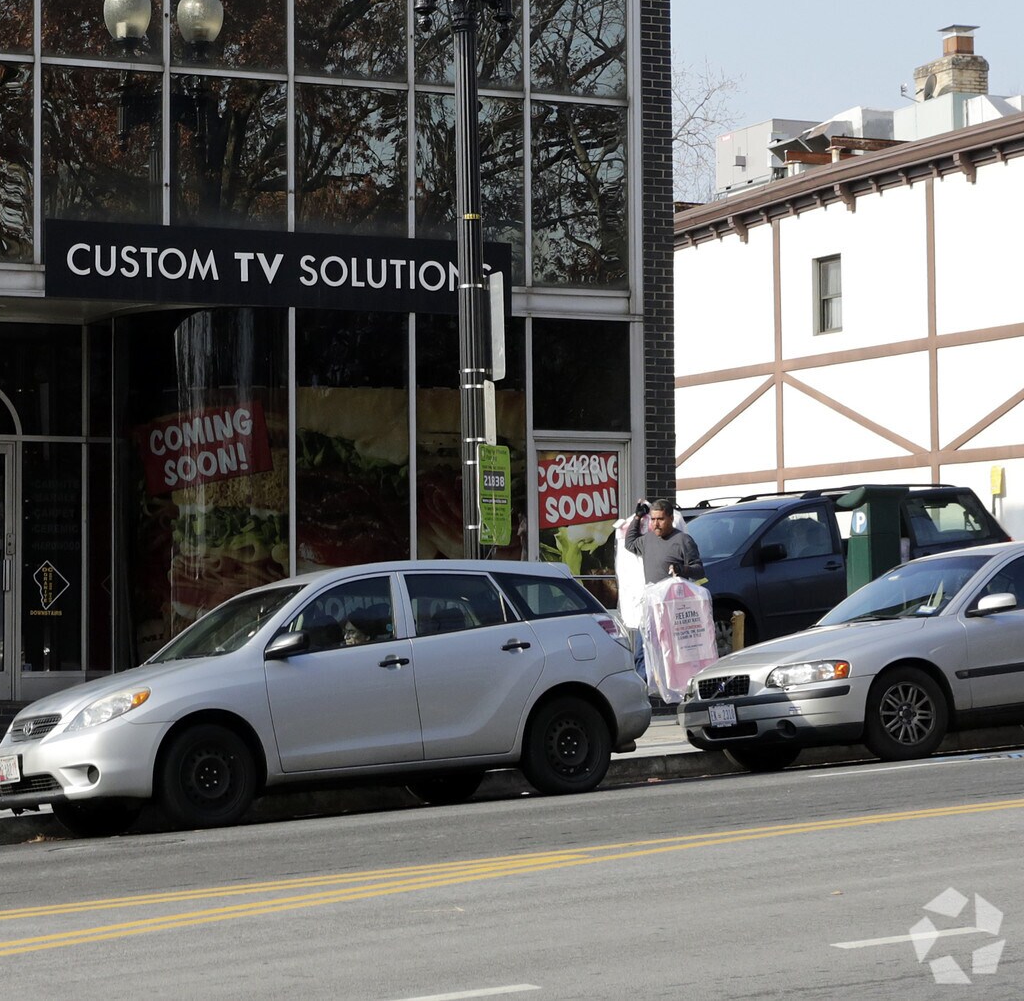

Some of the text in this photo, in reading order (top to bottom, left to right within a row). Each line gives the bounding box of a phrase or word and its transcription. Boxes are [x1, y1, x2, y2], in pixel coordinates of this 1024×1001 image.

[67, 243, 492, 292] CUSTOM TV SOLUTION
[149, 407, 253, 456] COMING
[164, 442, 249, 487] SOON!
[483, 475, 505, 487] 21838
[555, 454, 601, 474] 2428
[545, 487, 618, 523] SOON!
